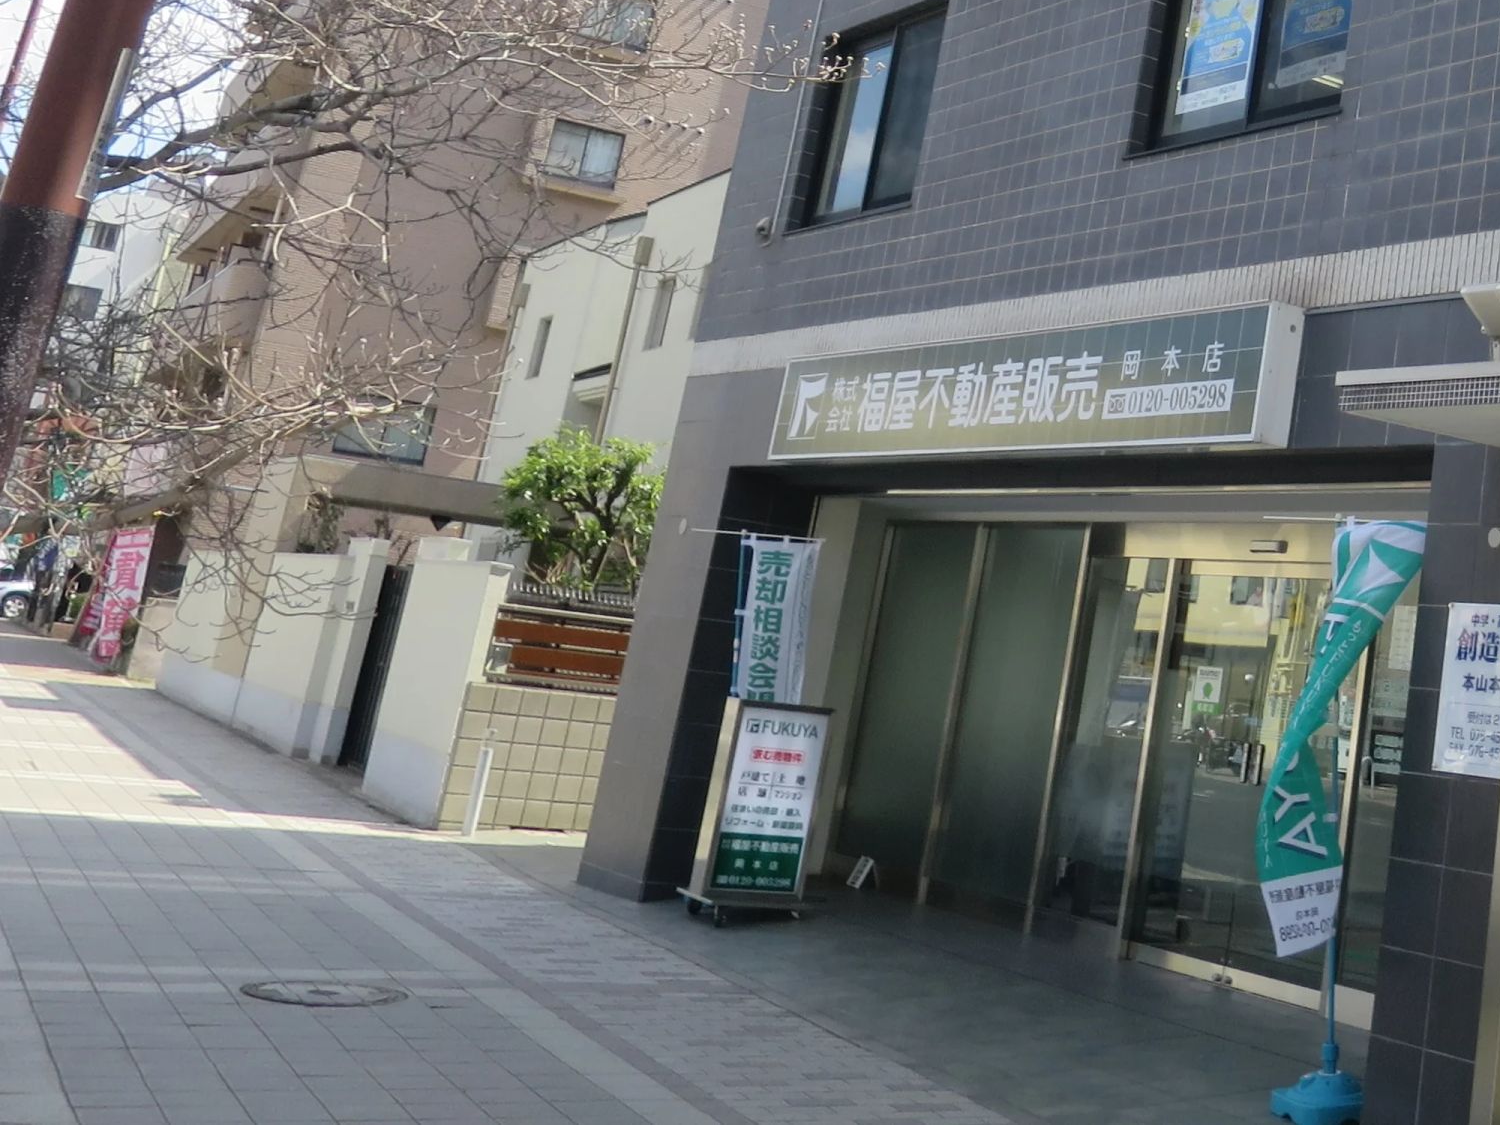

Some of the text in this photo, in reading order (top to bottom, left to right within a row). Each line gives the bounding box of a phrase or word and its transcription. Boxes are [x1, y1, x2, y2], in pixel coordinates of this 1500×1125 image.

[857, 350, 1104, 435] 福屋不動産販売
[1127, 383, 1228, 415] 0120-005298
[760, 720, 819, 739] FUKUYA
